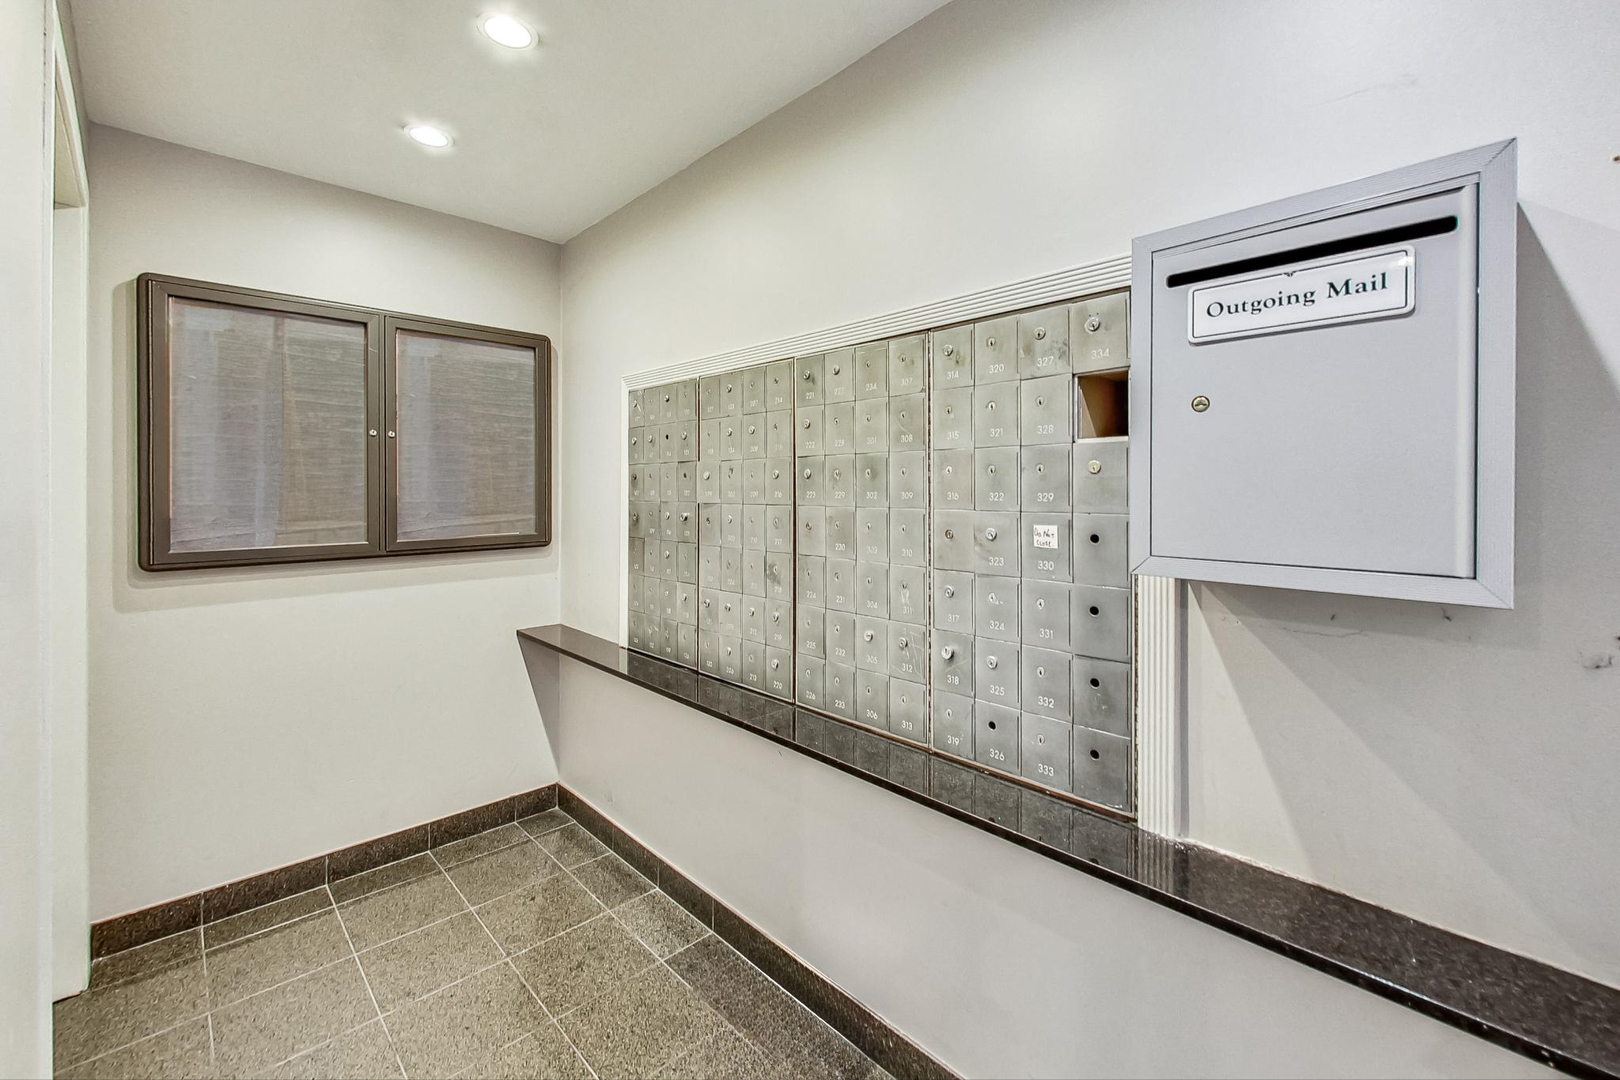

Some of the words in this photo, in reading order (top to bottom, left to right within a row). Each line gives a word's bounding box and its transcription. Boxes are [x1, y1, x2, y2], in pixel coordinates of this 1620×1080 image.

[1206, 289, 1316, 318] Outgoing
[1326, 272, 1388, 299] Mail
[1091, 348, 1110, 359] 334
[1037, 356, 1054, 367] 327
[988, 364, 1005, 374] 320
[946, 371, 959, 380] 314
[865, 382, 877, 391] 234
[990, 428, 1004, 438] 321
[1037, 424, 1054, 434] 328
[900, 433, 913, 443] 308
[947, 431, 959, 440] 315
[835, 491, 845, 499] 229
[866, 491, 877, 499] 302
[901, 492, 913, 500] 309
[947, 491, 959, 500] 316
[989, 492, 1005, 501] 322
[1037, 493, 1054, 502] 329
[902, 549, 913, 557] 310
[988, 557, 1004, 566] 323
[1037, 561, 1054, 570] 330
[947, 614, 960, 623] 317
[989, 620, 1005, 631] 324
[1039, 628, 1054, 638] 331
[866, 655, 878, 664] 305
[902, 663, 913, 673] 312
[947, 675, 959, 685] 318
[990, 685, 1005, 696] 325
[1037, 696, 1054, 708] 332
[866, 709, 878, 720] 306
[902, 721, 913, 731] 313
[947, 735, 960, 746] 319
[989, 749, 1005, 761] 326
[1037, 763, 1054, 777] 333
